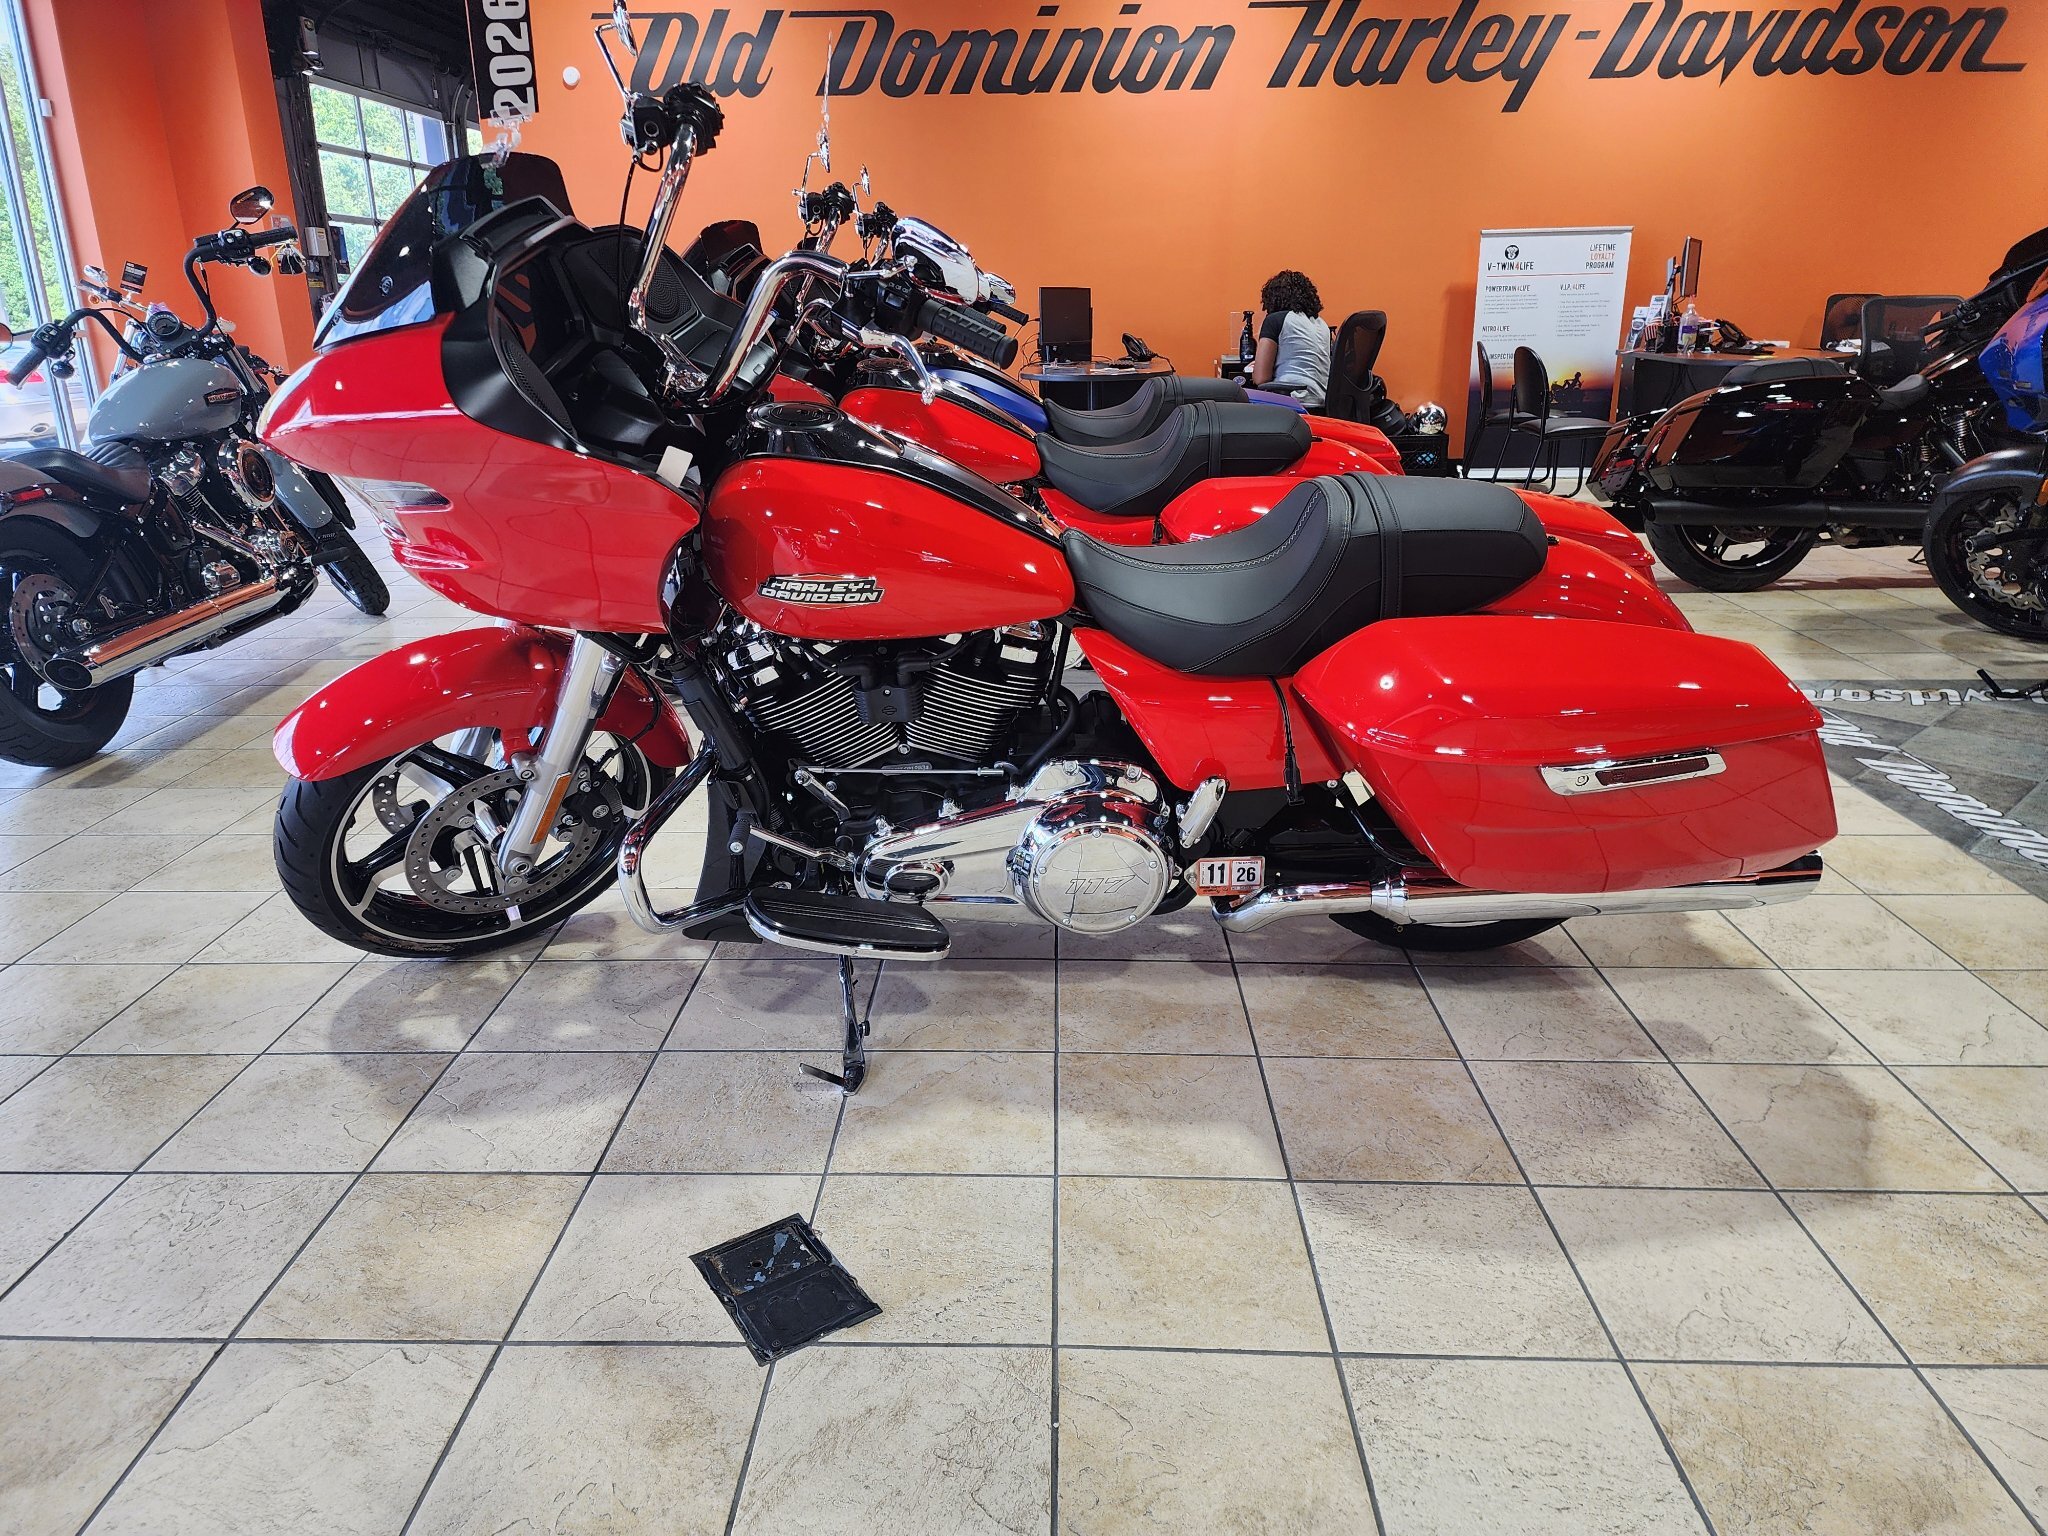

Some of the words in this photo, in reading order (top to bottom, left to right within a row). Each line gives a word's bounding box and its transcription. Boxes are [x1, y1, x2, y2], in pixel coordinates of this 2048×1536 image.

[590, 9, 785, 98] Old
[788, 4, 1237, 96] Dominion
[1589, 243, 1617, 252] LIFETIME
[1590, 252, 1615, 261] LOYALTY
[1487, 261, 1535, 271] V-TWIN4LIFE
[1585, 261, 1615, 269] PROGRAM
[771, 581, 871, 593] HARLEY-
[761, 587, 879, 602] DAVIDSON
[1208, 863, 1226, 884] 11
[1237, 867, 1256, 882] 26
[1065, 874, 1136, 895] 117
